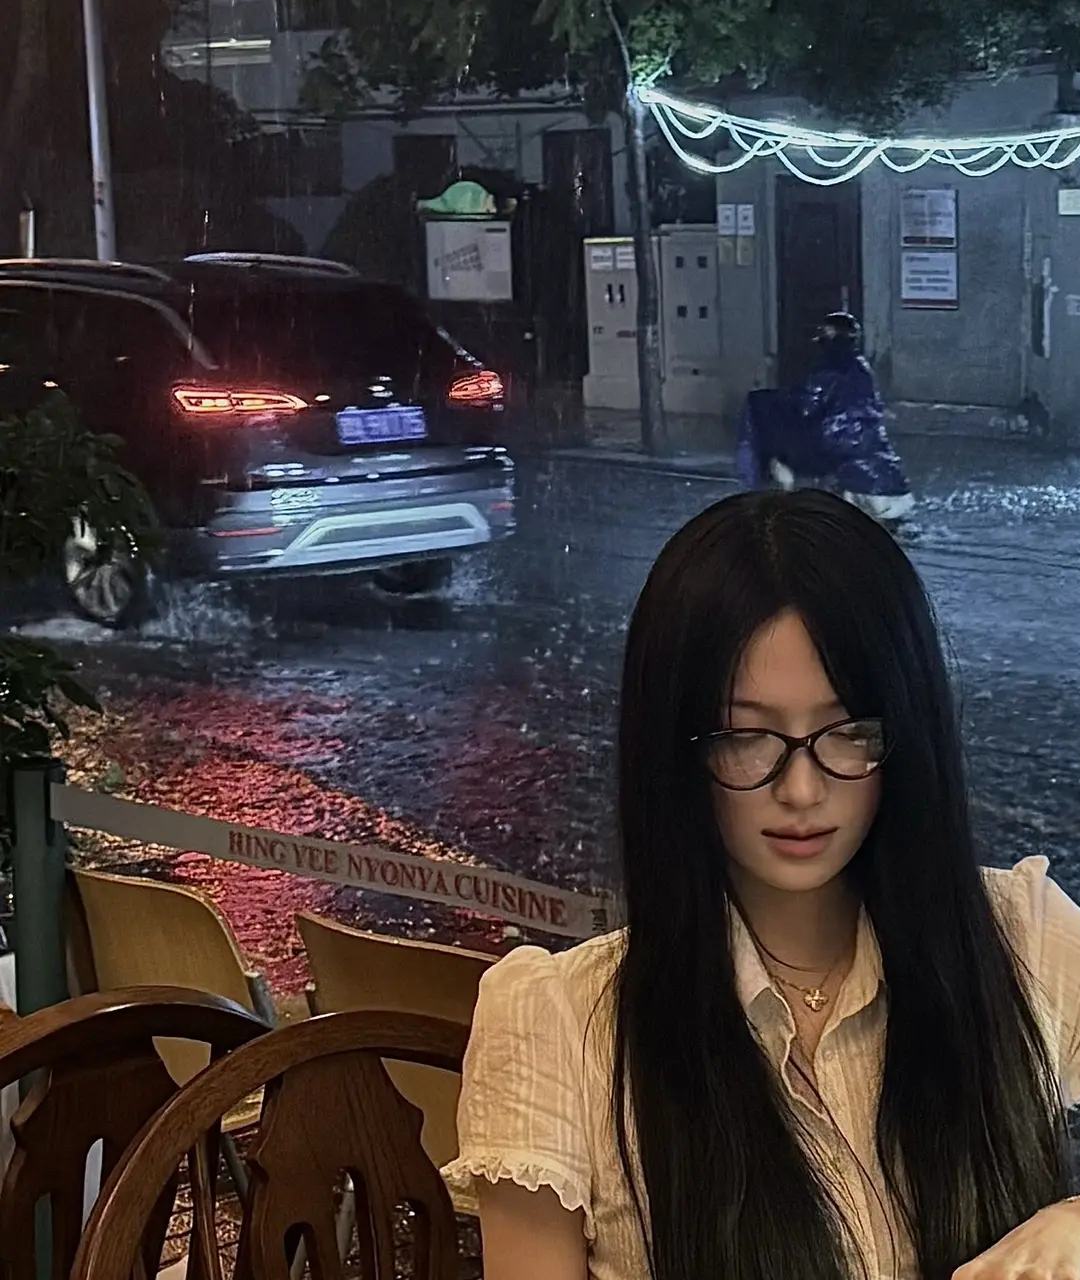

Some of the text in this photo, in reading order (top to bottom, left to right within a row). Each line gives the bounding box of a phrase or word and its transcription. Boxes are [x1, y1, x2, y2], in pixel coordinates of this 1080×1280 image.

[228, 830, 285, 866] HING
[292, 842, 338, 875] YEE
[347, 854, 449, 895] NYONYA
[454, 874, 567, 927] CUISINE
